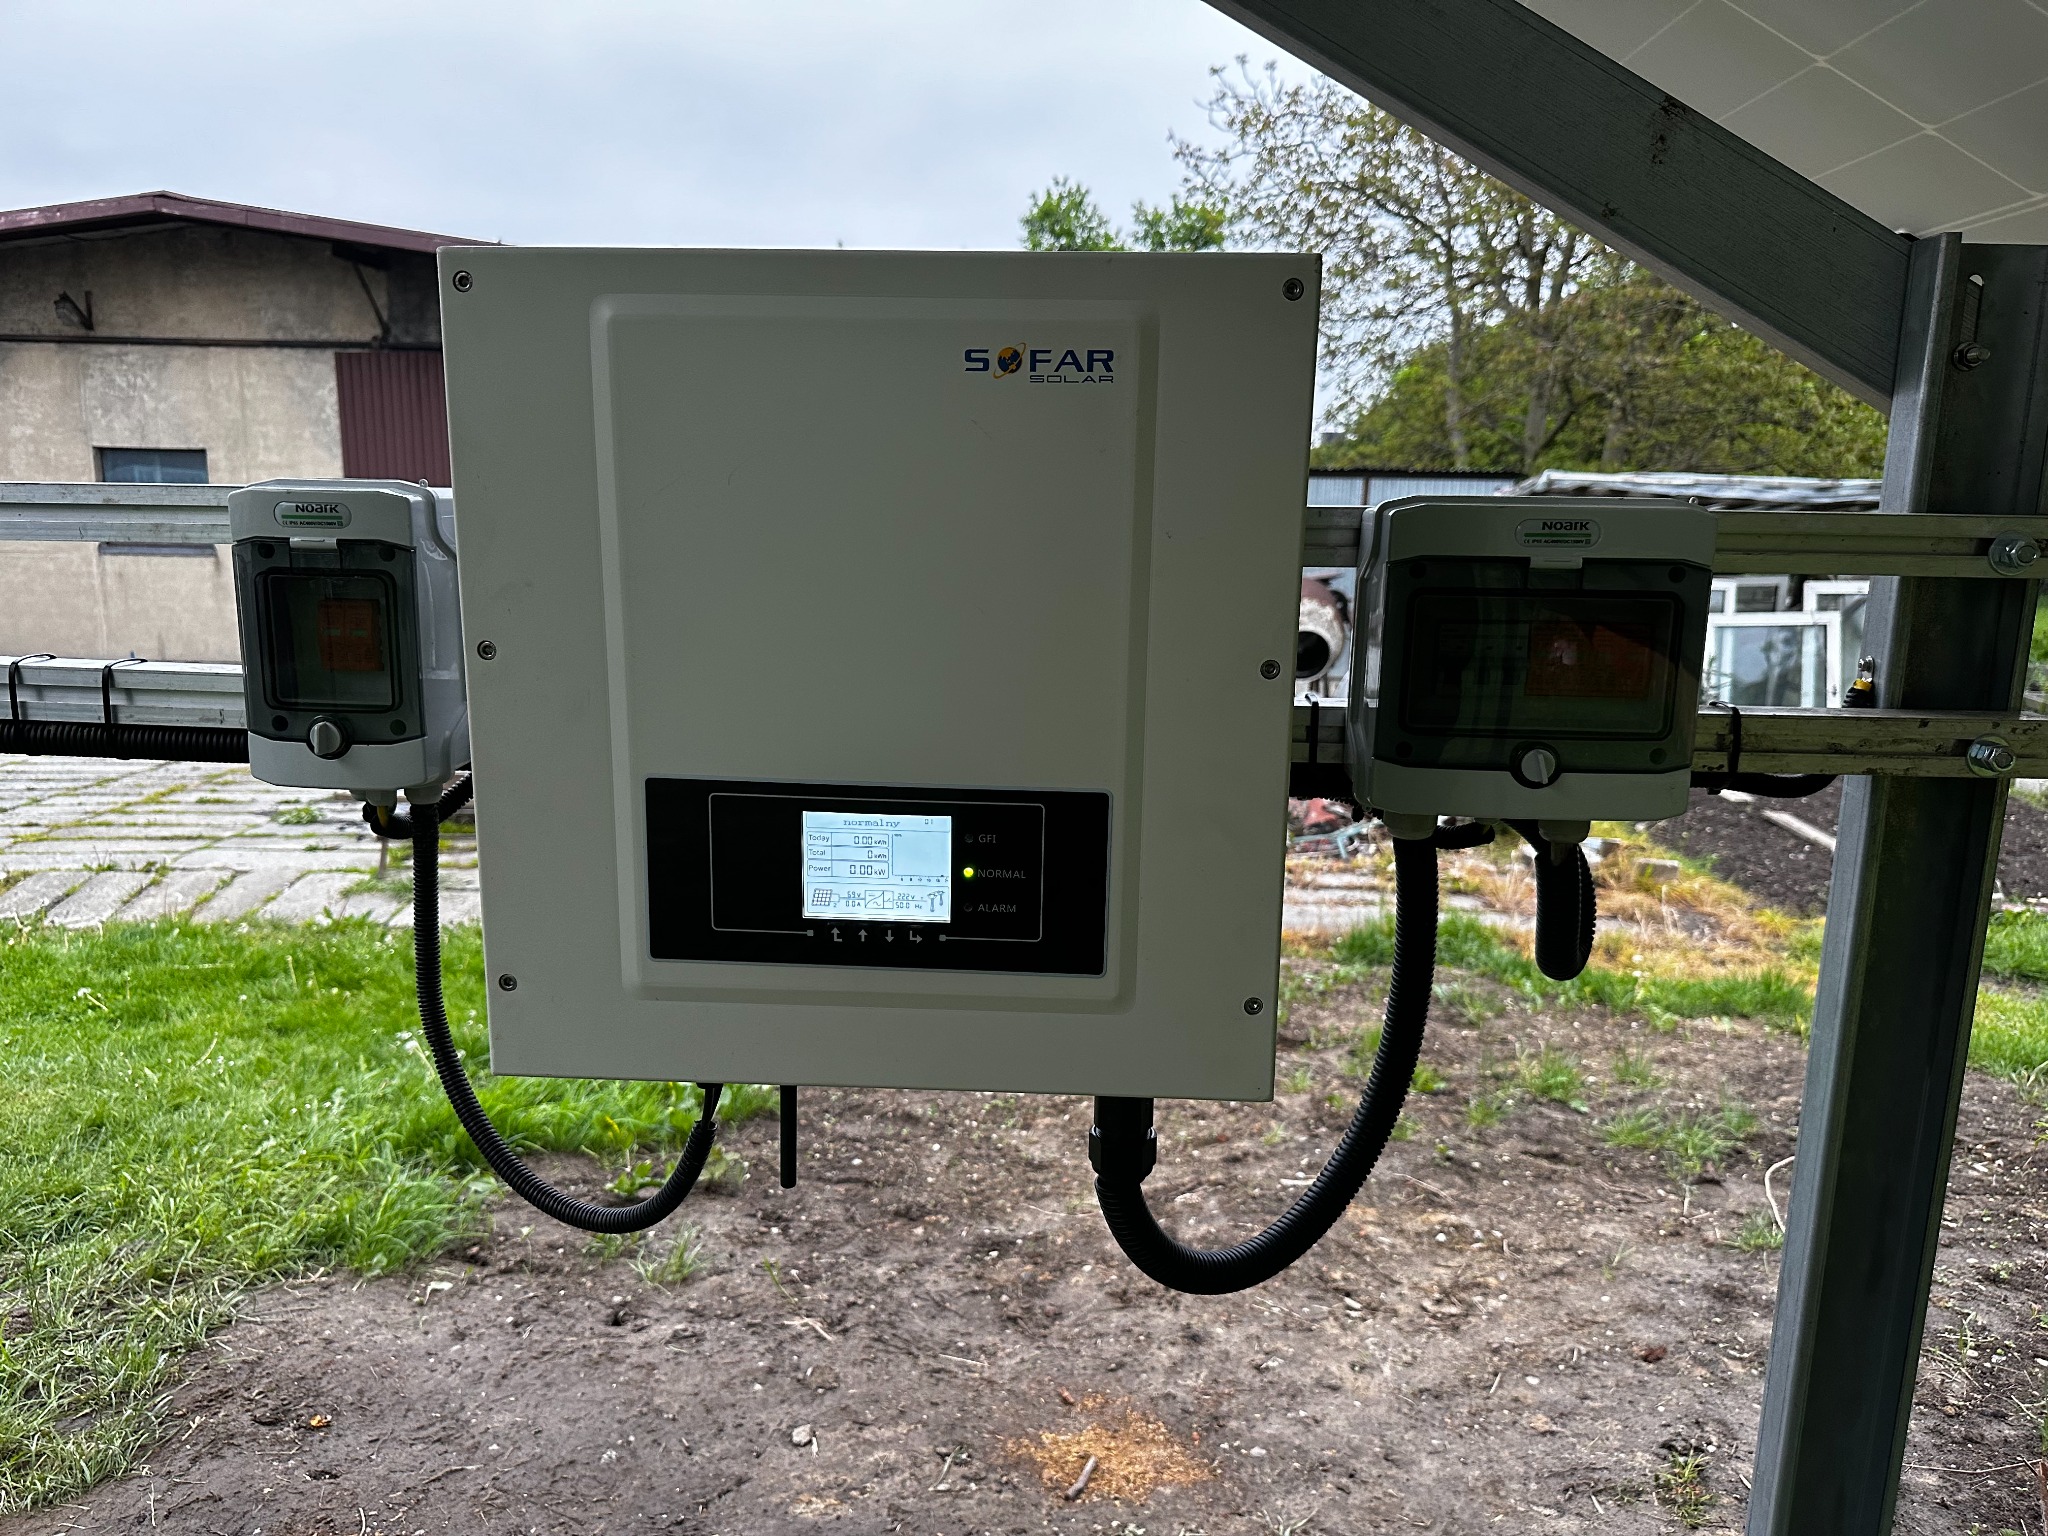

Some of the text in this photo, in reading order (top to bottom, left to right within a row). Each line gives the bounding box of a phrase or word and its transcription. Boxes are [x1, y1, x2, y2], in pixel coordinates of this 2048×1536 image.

[964, 346, 1114, 373] SOFAR
[1029, 374, 1114, 384] SOLAR
[843, 818, 900, 828] normalny
[808, 834, 830, 843] Today
[978, 834, 997, 843] GFI
[808, 848, 826, 856] Total
[808, 864, 831, 872] Power
[977, 869, 1026, 879] NORMAL
[977, 903, 1017, 913] ALARM
